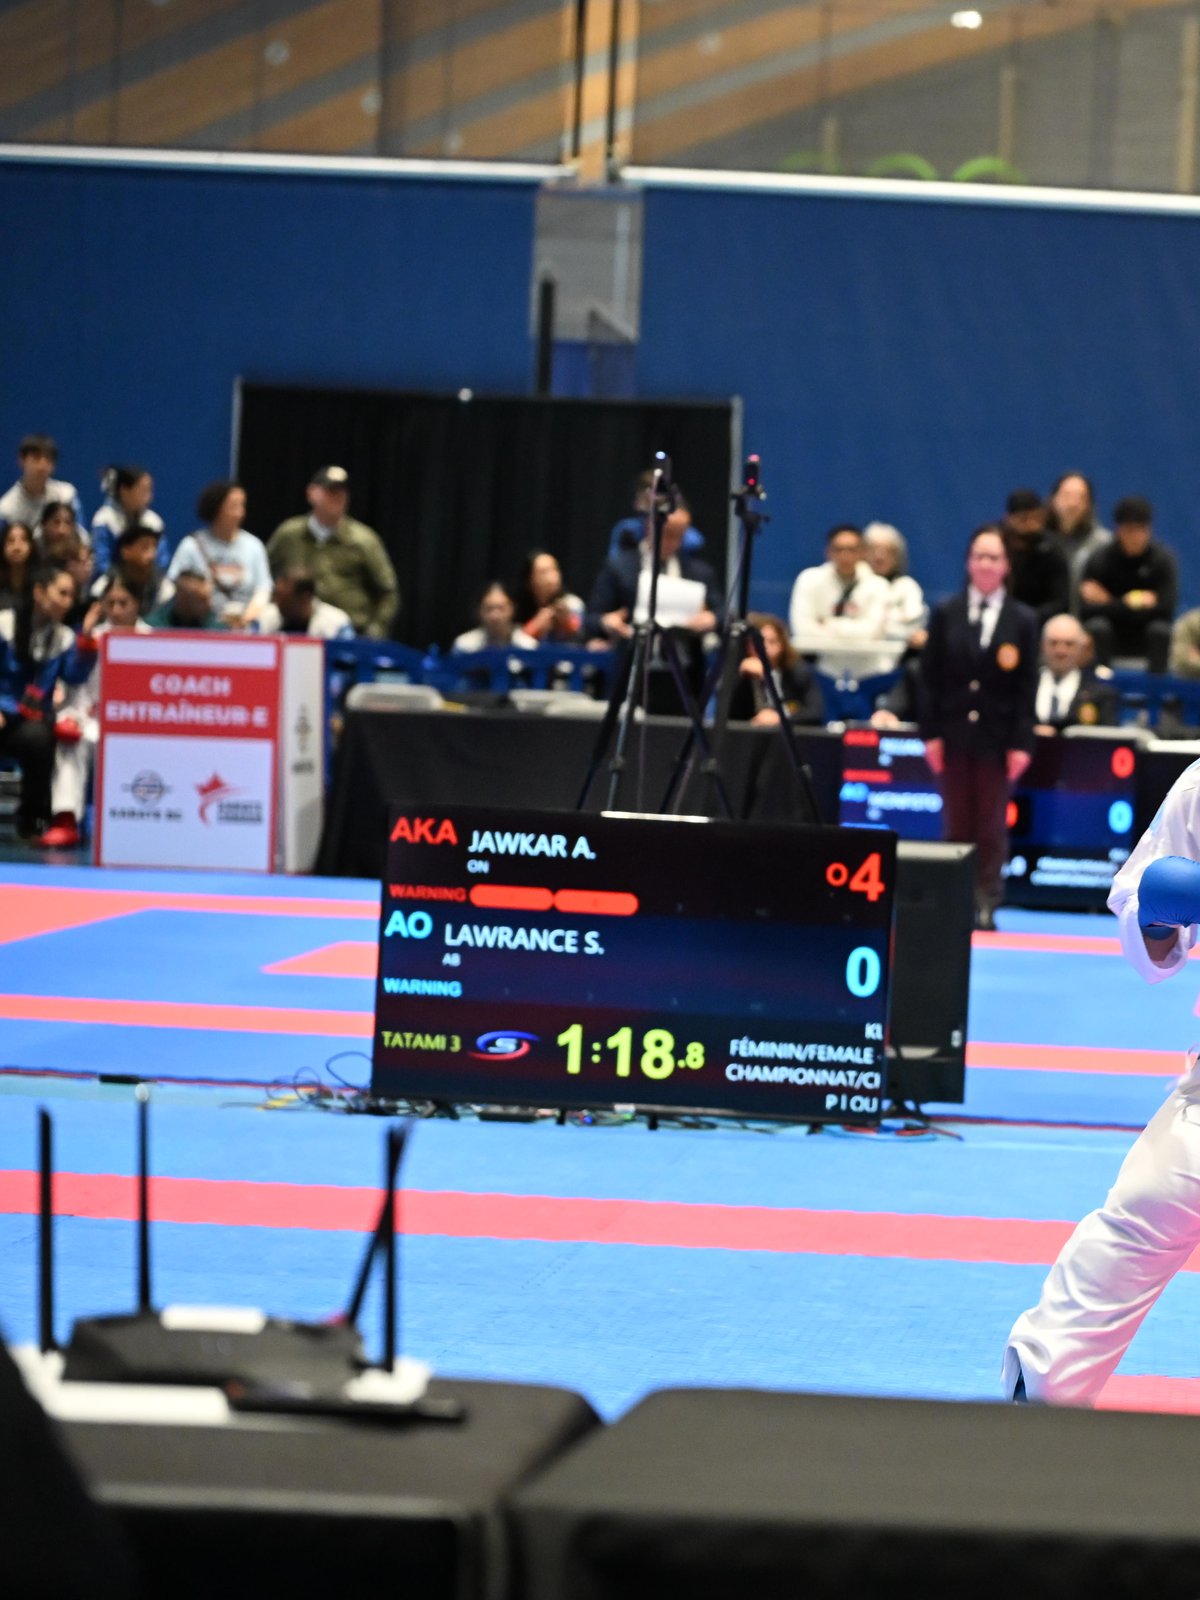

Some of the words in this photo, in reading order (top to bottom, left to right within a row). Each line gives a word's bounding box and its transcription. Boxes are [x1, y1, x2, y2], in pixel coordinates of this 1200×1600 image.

[150, 673, 231, 697] COACH
[390, 817, 458, 846] AKA
[468, 830, 567, 858] JAWKAR
[571, 836, 597, 860] A.
[467, 859, 490, 874] ON
[849, 853, 884, 902] 4
[390, 884, 467, 902] WARNING
[384, 910, 433, 939] AO
[445, 924, 579, 954] LAWRANCE
[584, 931, 605, 954] S.
[846, 947, 881, 998] 0
[383, 977, 463, 998] WARNING
[382, 1030, 447, 1051] TATAMI
[449, 1035, 462, 1053] 3
